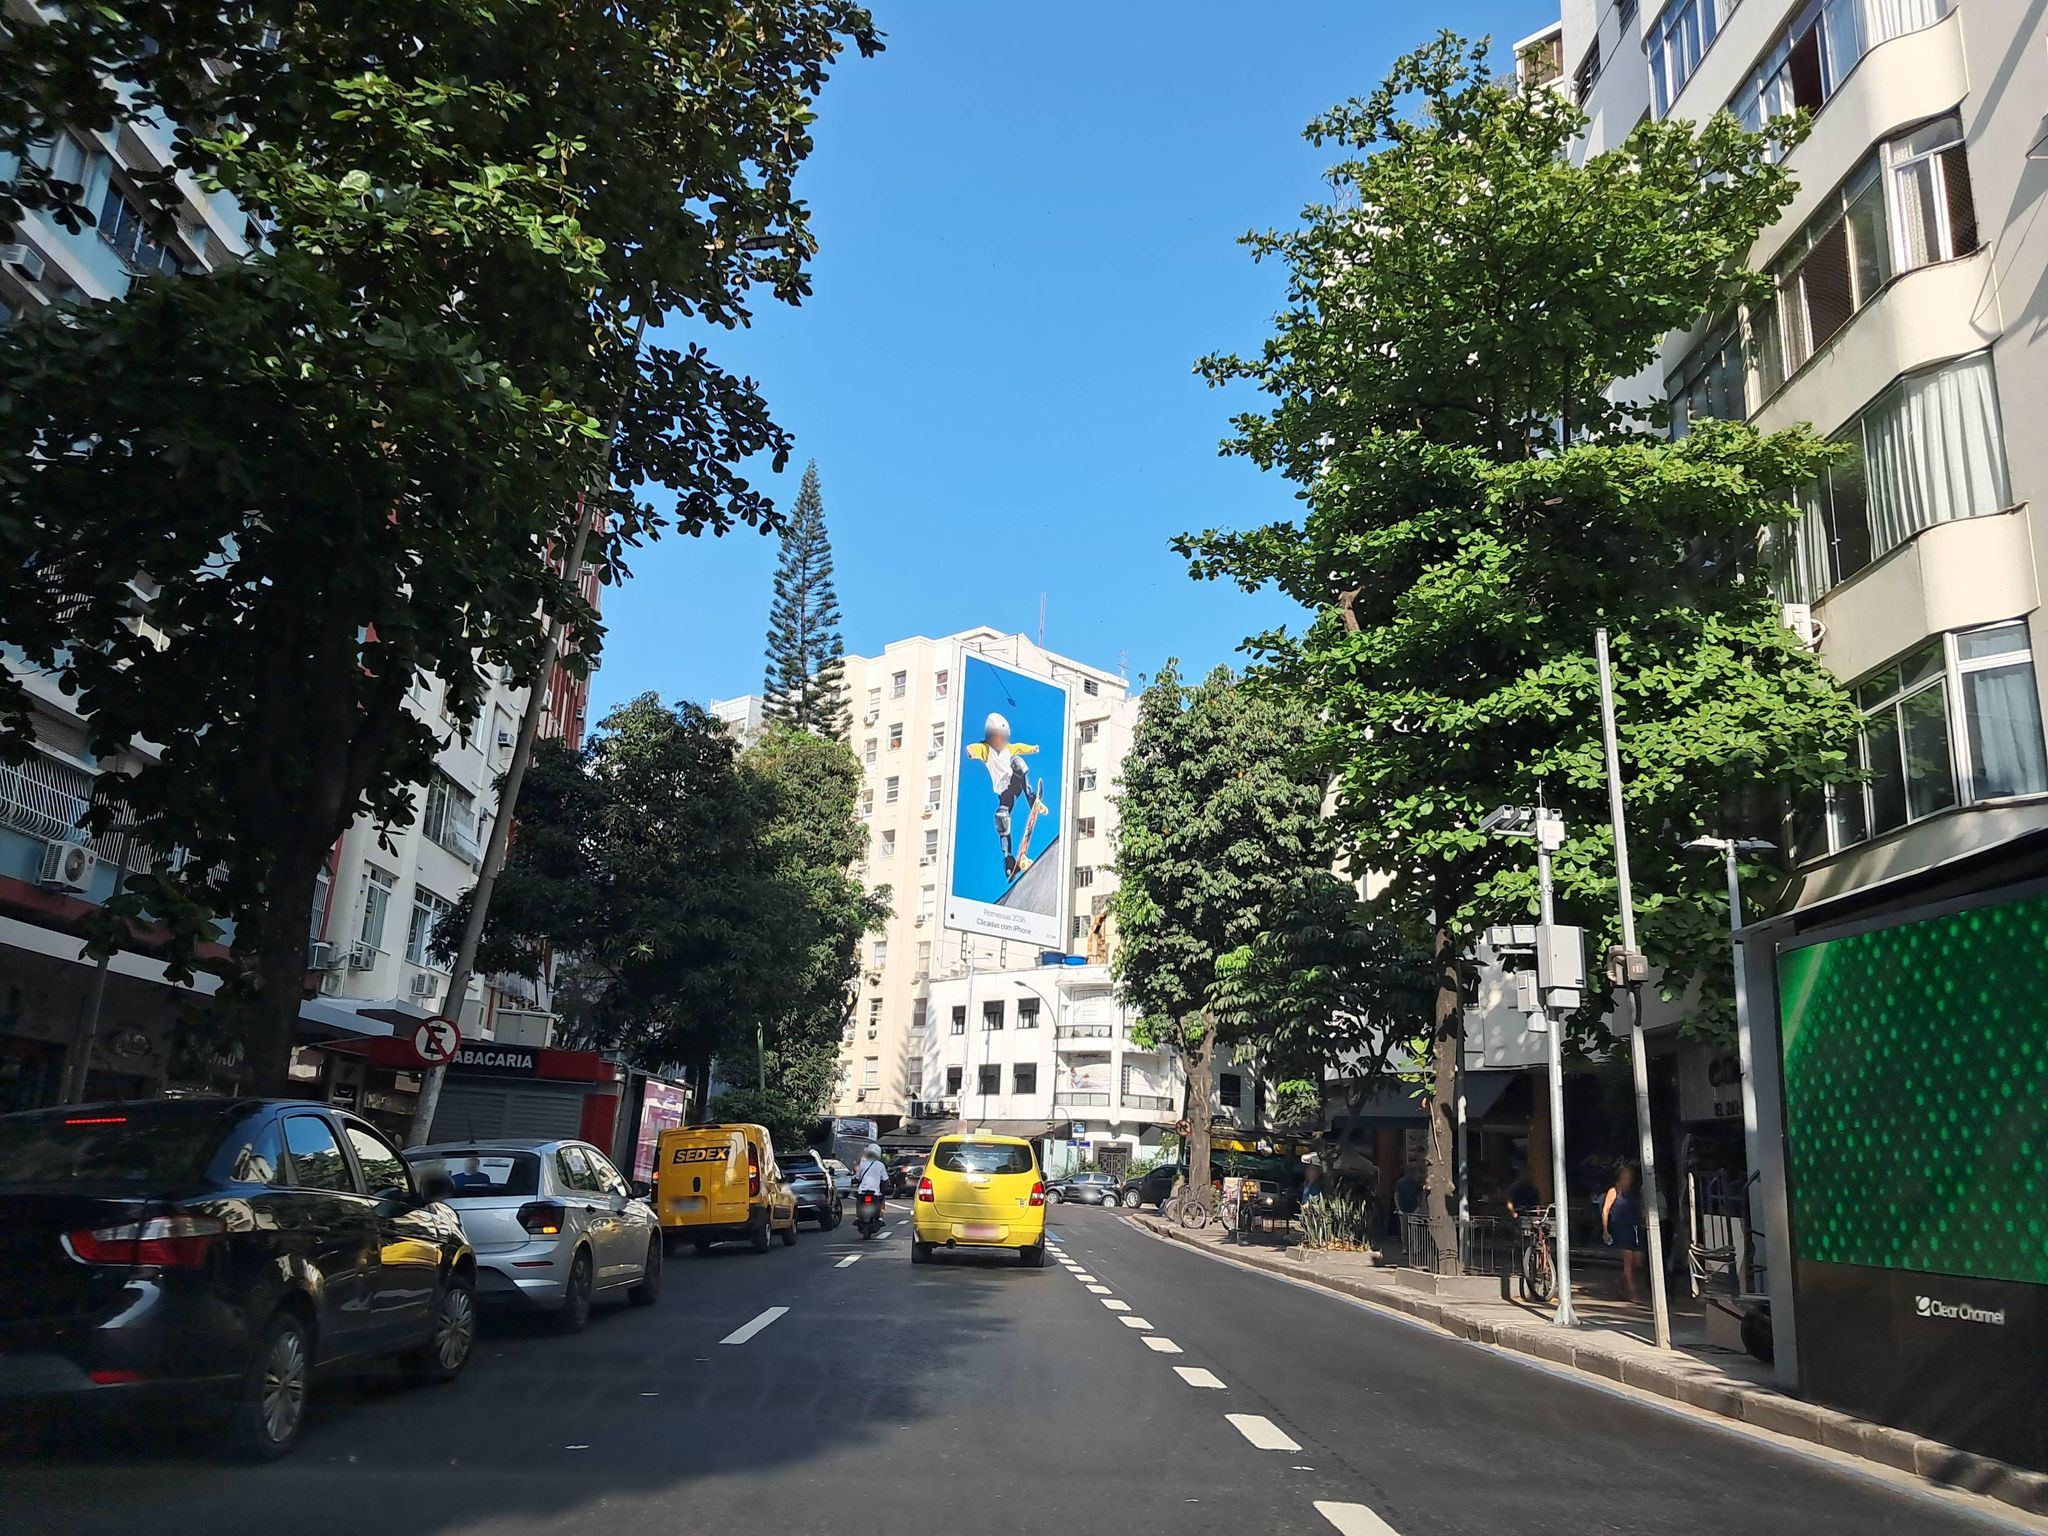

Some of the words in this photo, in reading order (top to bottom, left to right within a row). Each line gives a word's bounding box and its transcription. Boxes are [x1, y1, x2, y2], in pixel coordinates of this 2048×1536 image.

[983, 908, 1011, 921] Promessas
[976, 918, 1000, 929] Clicadas
[1013, 924, 1032, 935] iPhone
[424, 1025, 447, 1055] E
[447, 1050, 533, 1069] ABACARIA
[675, 1147, 727, 1163] SEDEX
[1930, 1300, 1958, 1318] Clear
[1959, 1303, 2005, 1325] Channel
